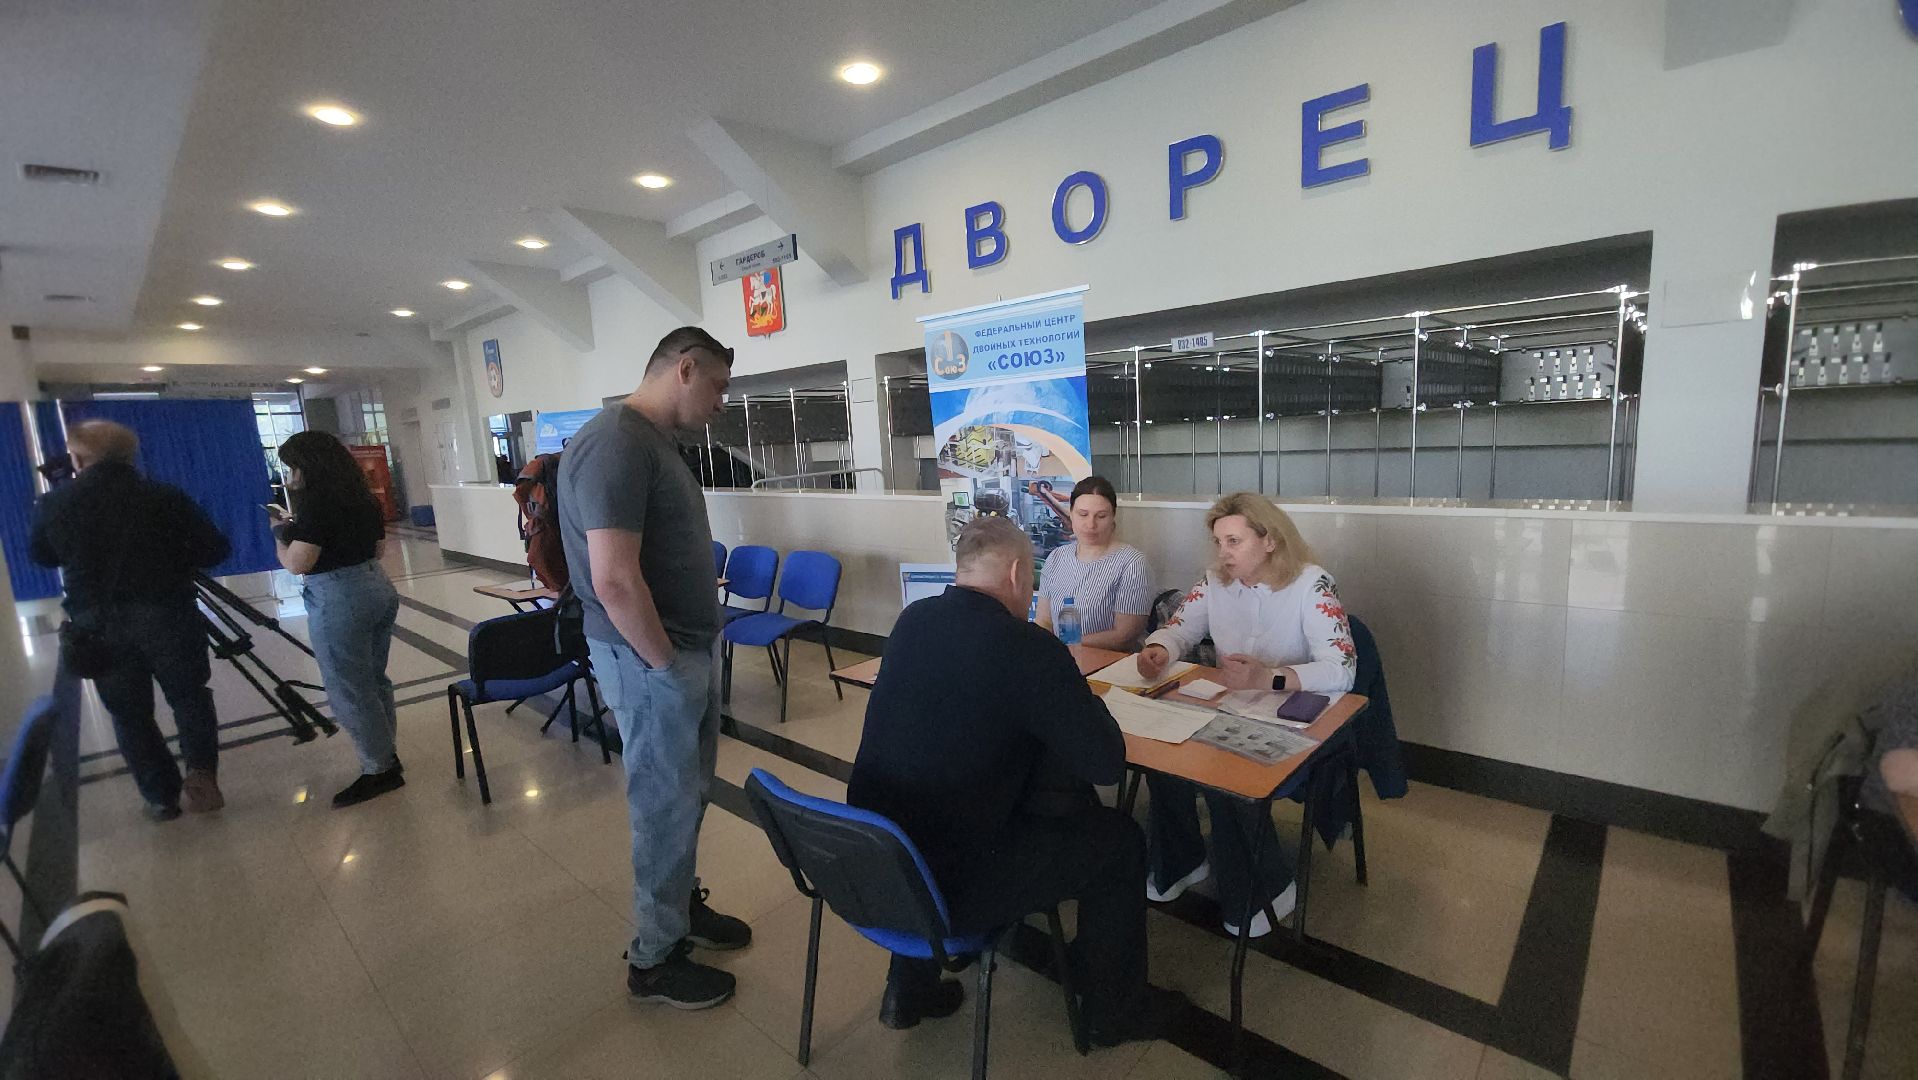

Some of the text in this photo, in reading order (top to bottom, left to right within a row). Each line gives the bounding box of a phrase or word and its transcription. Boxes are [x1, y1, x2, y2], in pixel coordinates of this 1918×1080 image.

[890, 21, 1573, 300] ДВОРЕЦ
[1044, 314, 1076, 328] ЦЕНТР
[987, 348, 1066, 371] «СОЮЗ»
